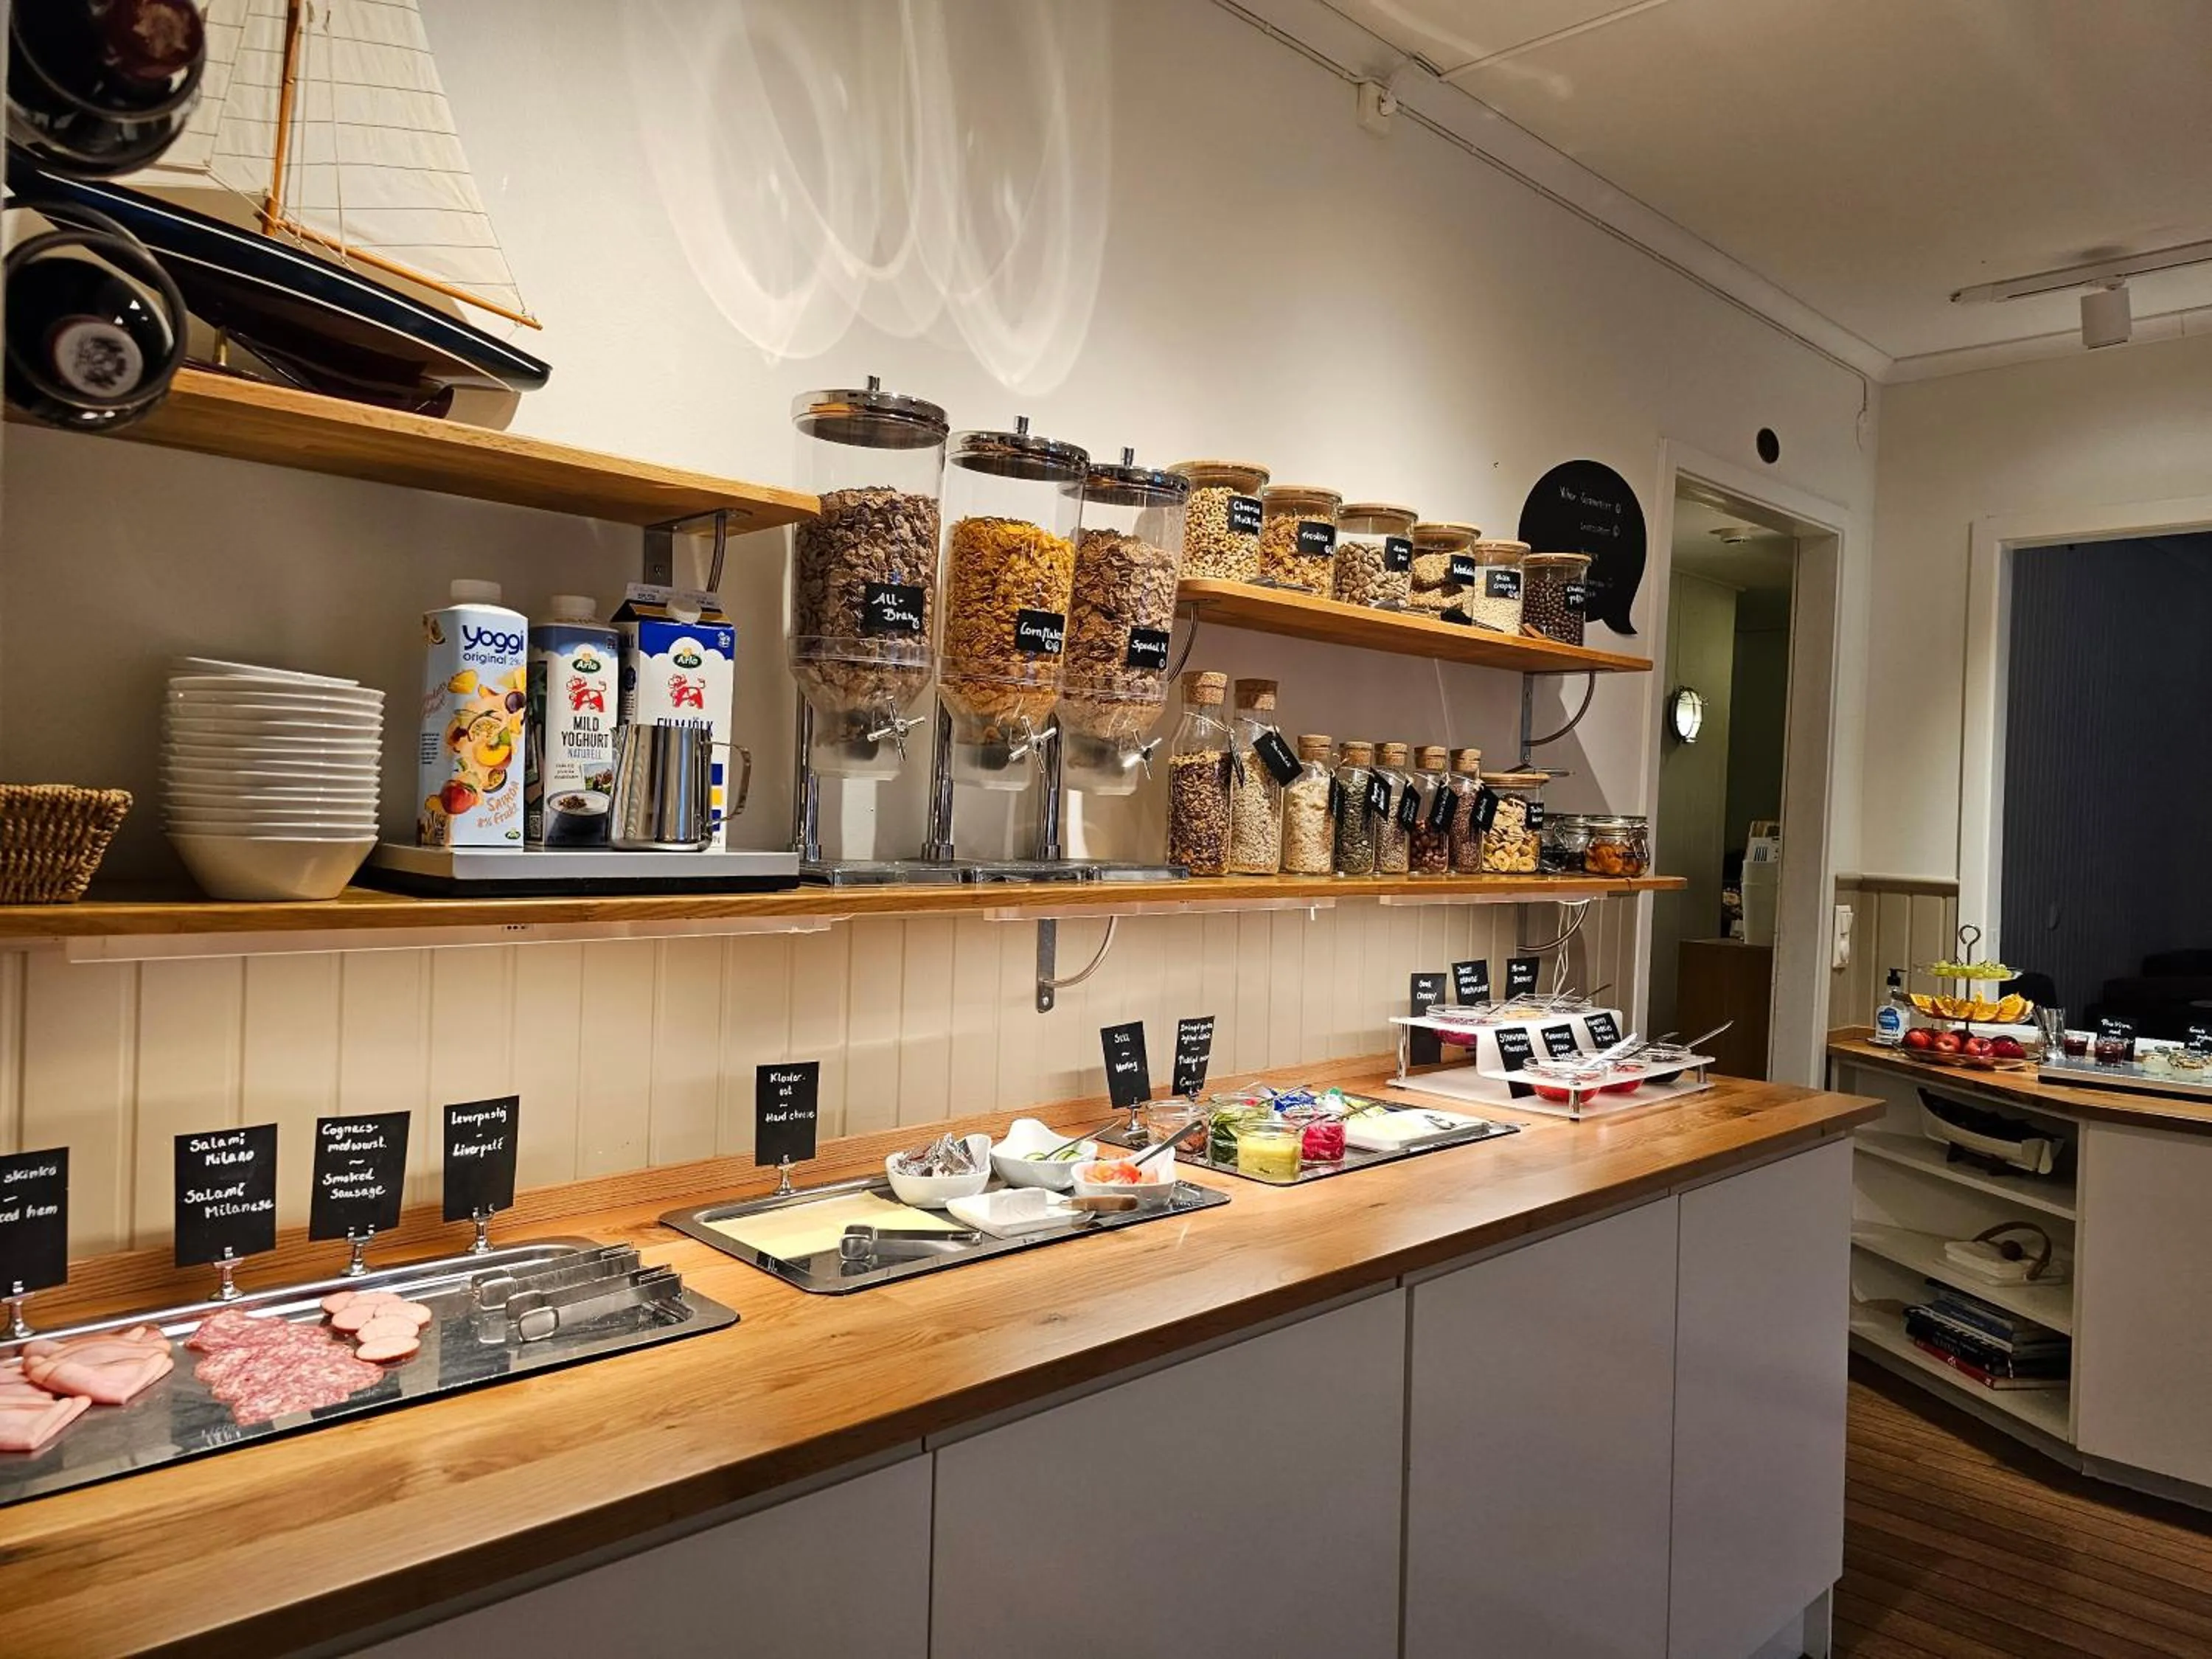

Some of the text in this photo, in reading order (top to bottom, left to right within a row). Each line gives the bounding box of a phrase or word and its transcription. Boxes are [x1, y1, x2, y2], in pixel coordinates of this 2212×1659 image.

[462, 624, 524, 655] yoggi
[462, 652, 507, 664] original
[577, 660, 597, 671] Arla
[676, 654, 700, 665] Arla
[573, 716, 599, 731] MILD
[561, 731, 610, 748] YOGHURT
[189, 1132, 246, 1152] Salami
[205, 1150, 255, 1166] Milano
[322, 1168, 375, 1186] Smoked
[184, 1182, 246, 1204] Salami
[330, 1185, 386, 1200] Sausage
[204, 1199, 274, 1219] Milanese
